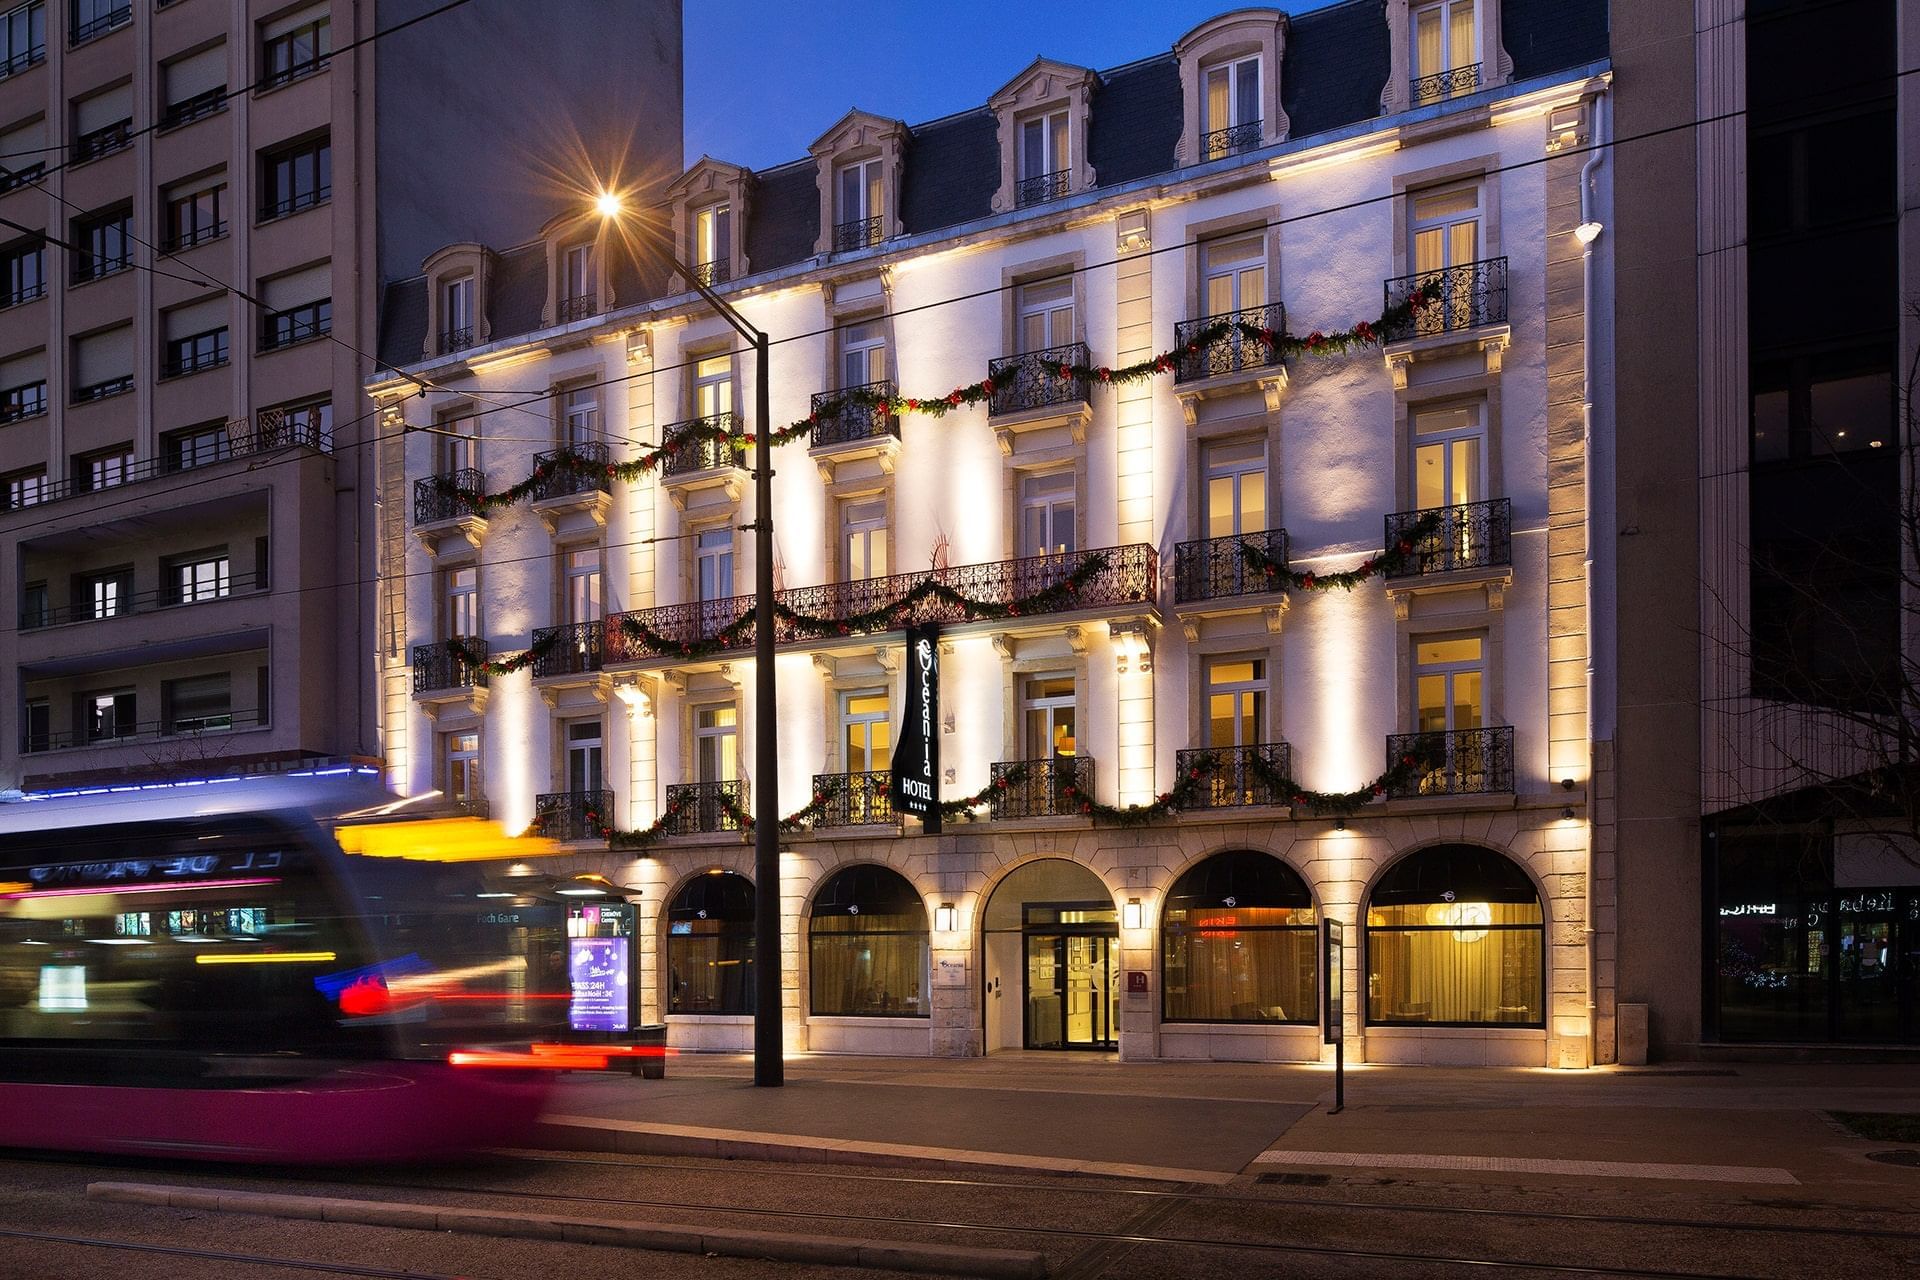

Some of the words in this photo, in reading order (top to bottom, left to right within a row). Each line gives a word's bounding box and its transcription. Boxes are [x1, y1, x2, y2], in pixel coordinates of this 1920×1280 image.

[903, 777, 932, 800] HOTEL
[498, 913, 519, 923] Gare
[1136, 975, 1145, 984] H
